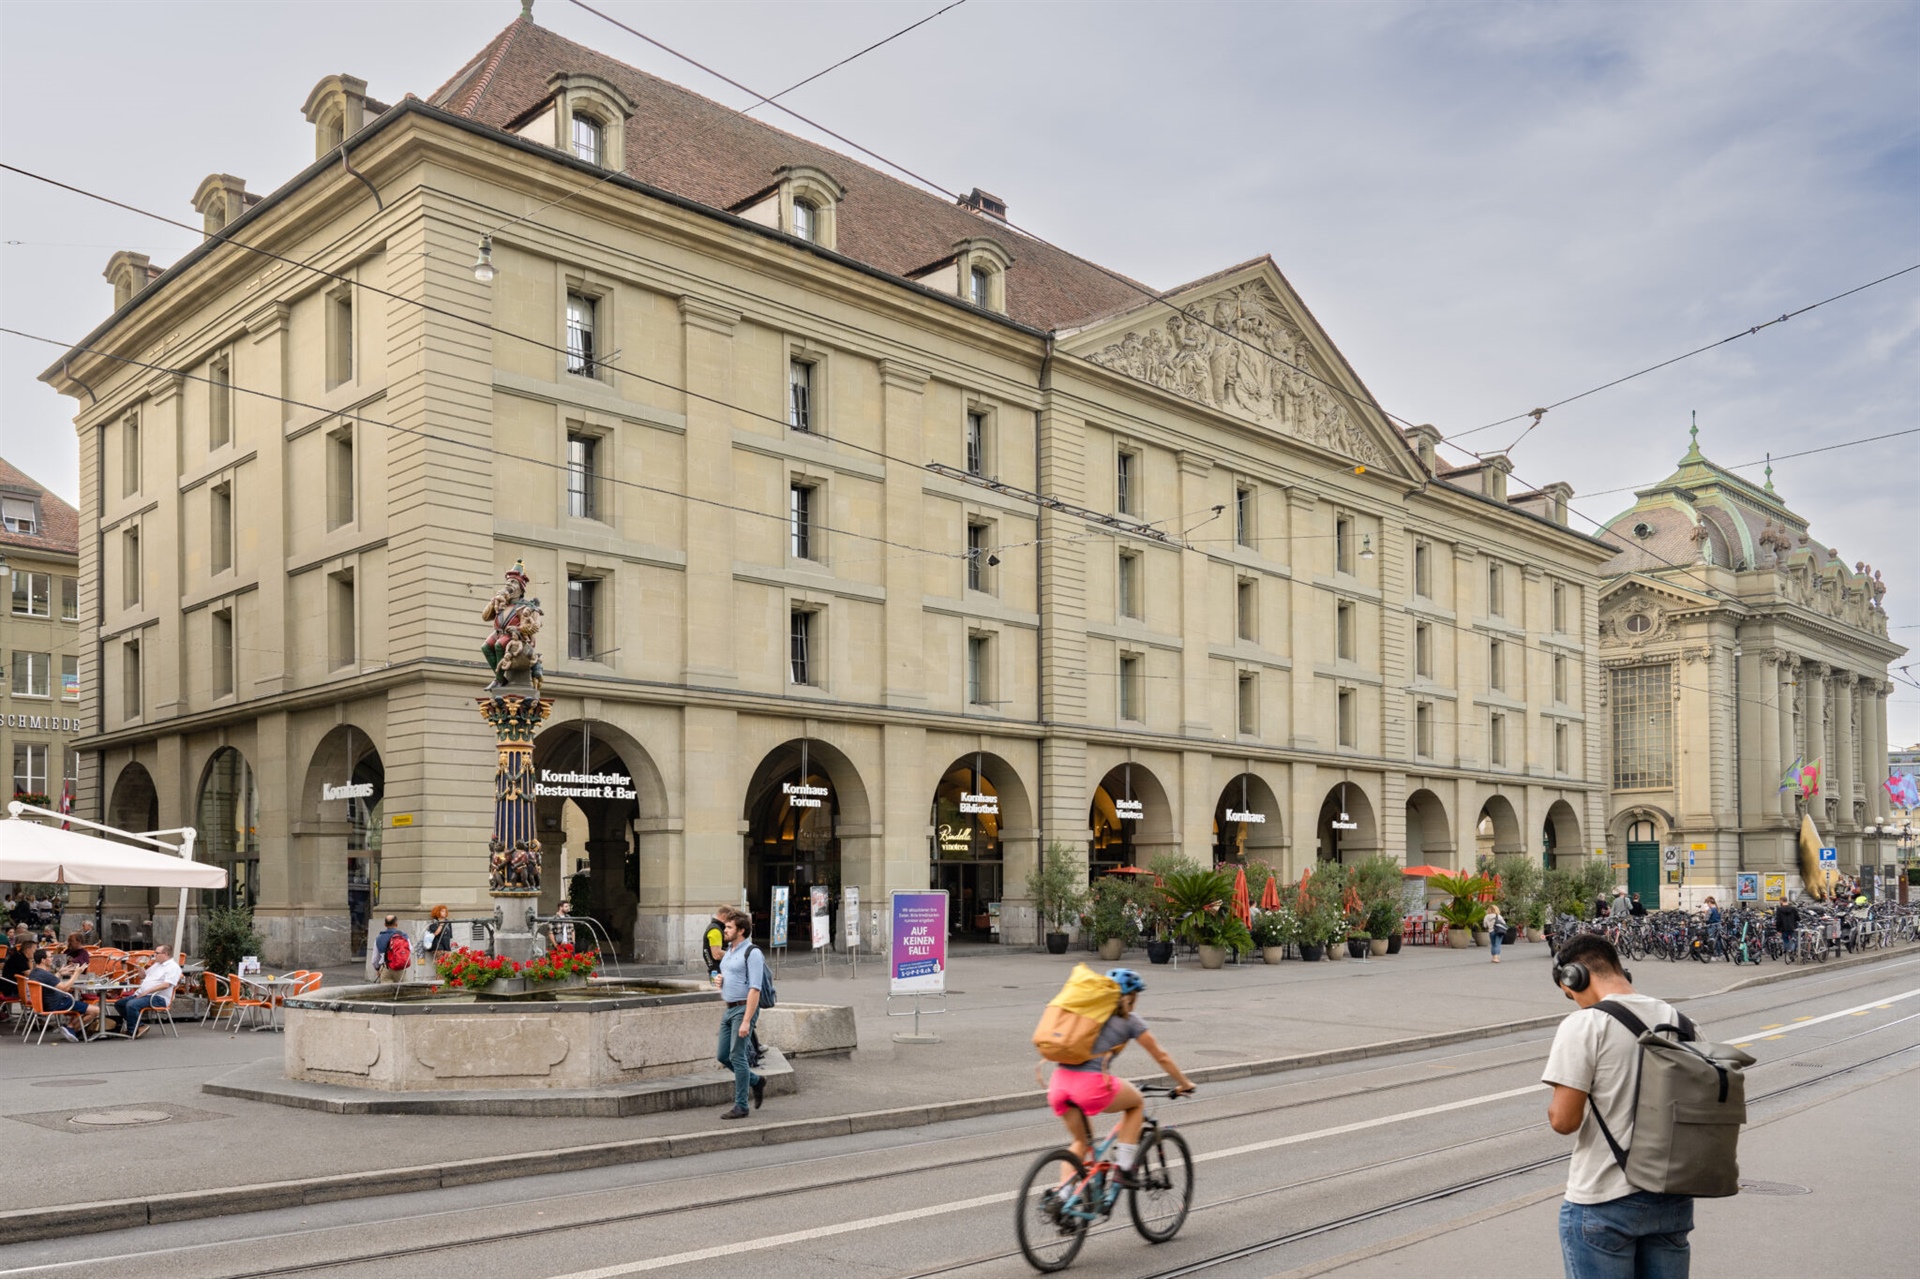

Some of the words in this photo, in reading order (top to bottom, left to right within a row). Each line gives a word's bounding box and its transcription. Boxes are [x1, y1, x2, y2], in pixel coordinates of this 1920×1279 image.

[541, 769, 631, 785] Kornhauskeller
[323, 781, 374, 800] Kornhaus
[535, 783, 602, 797] Restaurant
[603, 786, 614, 798] &
[616, 787, 637, 799] Bar
[783, 783, 828, 796] Kornhaus
[790, 795, 821, 807] Forum
[961, 792, 998, 803] Kornhaus
[960, 803, 999, 814] Bibliothek
[1226, 809, 1266, 823] Kornhaus
[941, 842, 969, 851] vinoteca
[1823, 850, 1832, 859] P
[911, 926, 928, 935] AUF
[903, 936, 935, 945] KEINEN
[908, 946, 930, 955] FALL!
